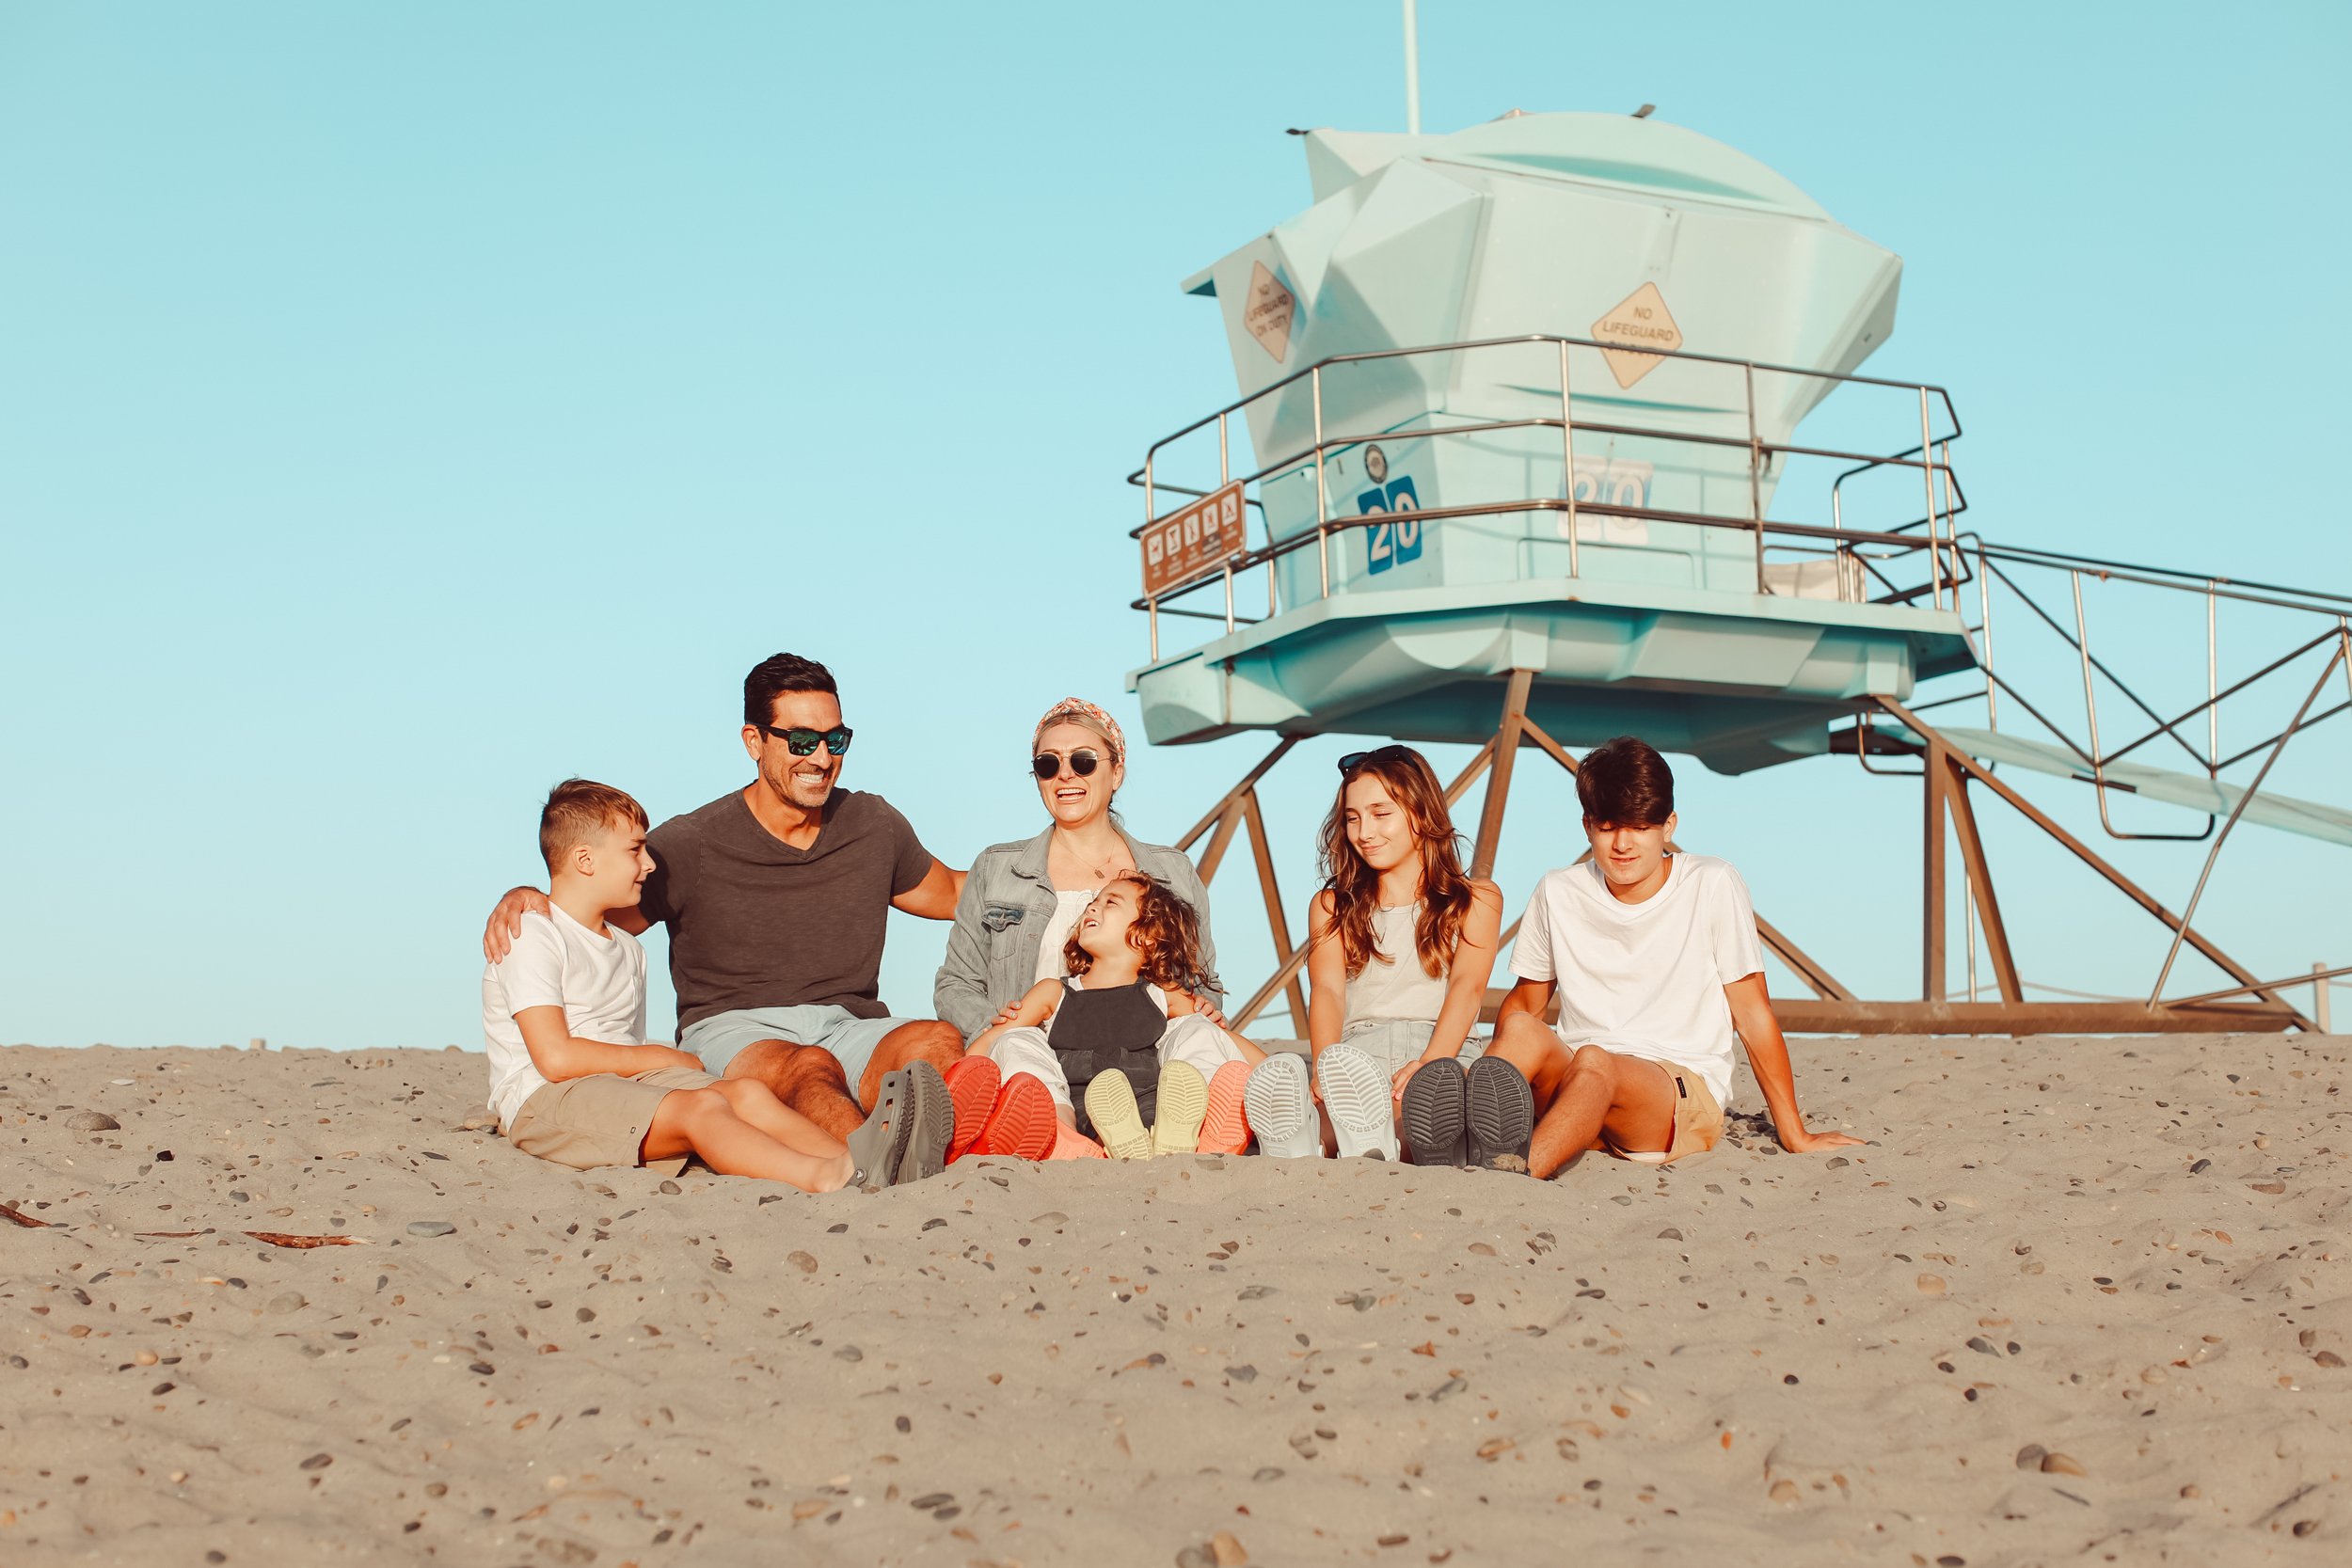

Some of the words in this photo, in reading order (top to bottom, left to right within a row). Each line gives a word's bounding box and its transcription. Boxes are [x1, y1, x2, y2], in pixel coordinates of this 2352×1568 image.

[1633, 307, 1653, 321] NO
[1602, 321, 1674, 341] LIFEGUARD
[1367, 492, 1419, 562] 20
